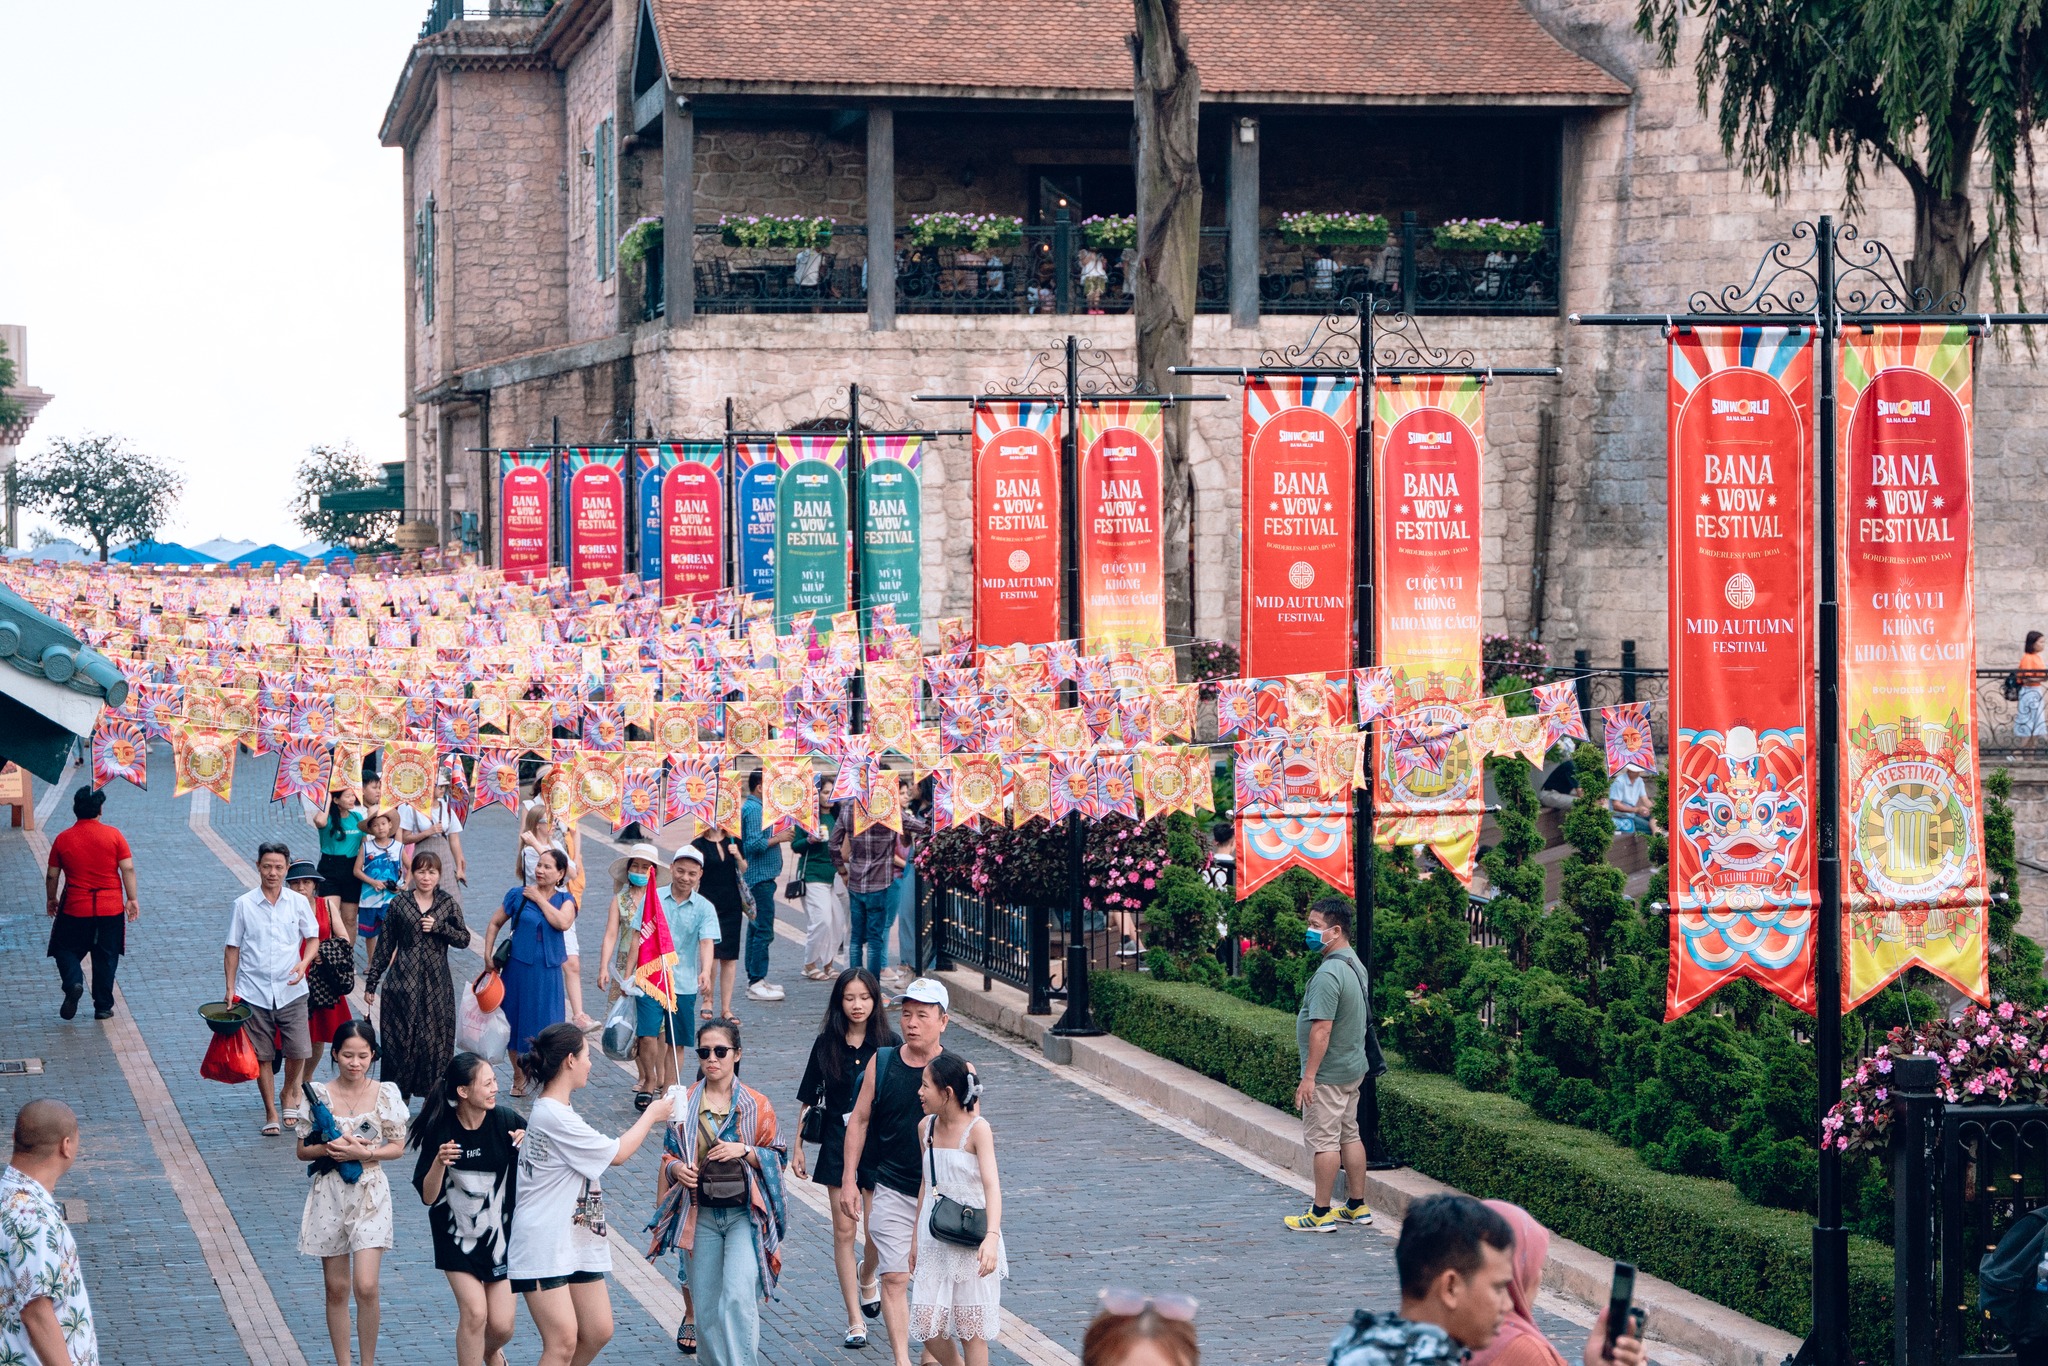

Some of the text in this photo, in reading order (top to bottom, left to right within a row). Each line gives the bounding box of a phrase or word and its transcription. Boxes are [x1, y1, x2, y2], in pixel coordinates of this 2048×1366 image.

[1877, 399, 1930, 416] SNWORLD
[1704, 454, 1774, 484] BANA
[1872, 454, 1939, 486] BANA
[996, 479, 1041, 497] BANA
[1101, 480, 1143, 499] BANA
[1274, 472, 1329, 495] BANA
[1404, 473, 1459, 497] BANA
[512, 496, 539, 506] BANA
[582, 497, 612, 509] BANA
[675, 500, 708, 513] BANA
[752, 498, 775, 511] BAN
[869, 500, 907, 516] BANA
[1003, 499, 1035, 514] WOW
[1282, 498, 1321, 515] WOW
[1716, 489, 1765, 512] WOW
[1883, 490, 1928, 514] WOW
[517, 507, 535, 515] WOW
[588, 510, 608, 520] WOW
[794, 501, 832, 517] BANA
[1104, 501, 1136, 516] WOW
[1413, 500, 1451, 518] WOW
[508, 516, 543, 525] FESTIVAL
[578, 520, 617, 529] FESTIVAL
[681, 514, 704, 524] WOW
[800, 519, 827, 531] WOW
[875, 517, 903, 530] WOW
[989, 515, 1048, 530] FESTIVAL
[1094, 518, 1152, 534] FESTIVAL
[1695, 515, 1783, 538] FESTIVAL
[670, 526, 714, 536] FESTIVAL
[748, 524, 774, 534] FESTI
[1264, 518, 1338, 536] FESTIVAL
[1396, 521, 1470, 540] FESTIVAL
[1860, 518, 1954, 542] FESTIVAL
[787, 532, 839, 545] FESTIVAL
[865, 531, 914, 544] FESTIVAL
[671, 554, 714, 564] KOREAN
[983, 577, 1054, 588] MID AUTUMN
[1406, 574, 1462, 593] CUỘC VUI
[1000, 591, 1038, 599] FESTIVAL
[1256, 596, 1344, 608] MID AUTUMN
[1414, 594, 1456, 610] KHÔNG
[1872, 588, 1944, 614] CUỘC VUI
[1278, 613, 1324, 622] FESTIVAL
[1445, 613, 1476, 629] CÁCH
[1883, 614, 1934, 636] KHÔNG
[1686, 618, 1794, 634] MID AUTUMN
[1713, 641, 1768, 652] FESTIVAL
[1855, 640, 1965, 662] KHOẢNG CÁCH
[1111, 667, 1143, 678] ESTIVA
[1432, 708, 1456, 723] TIVAL
